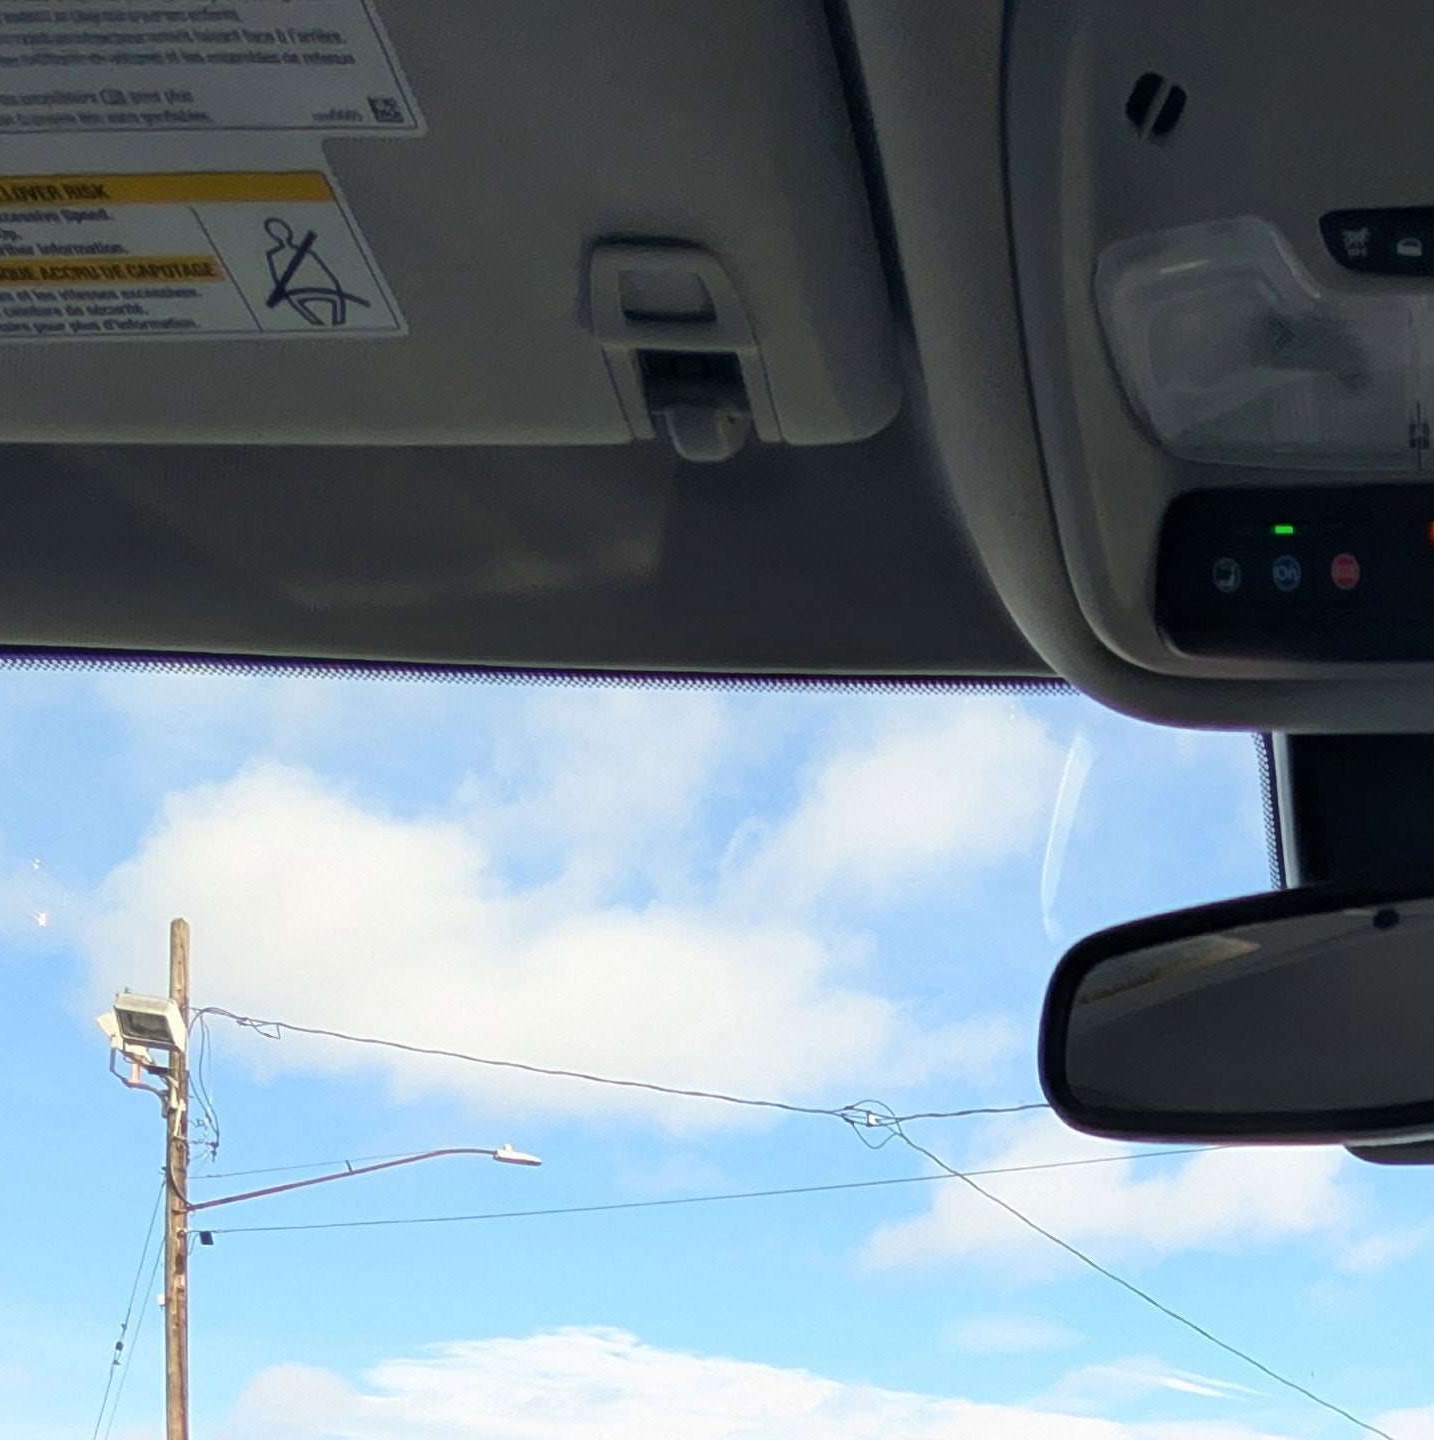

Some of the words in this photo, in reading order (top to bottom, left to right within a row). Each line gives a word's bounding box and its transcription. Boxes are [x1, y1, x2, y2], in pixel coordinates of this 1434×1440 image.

[62, 184, 110, 200] RISK
[39, 267, 101, 280] ACCRU
[100, 264, 122, 280] DE
[125, 263, 215, 278] CAPOTAGE
